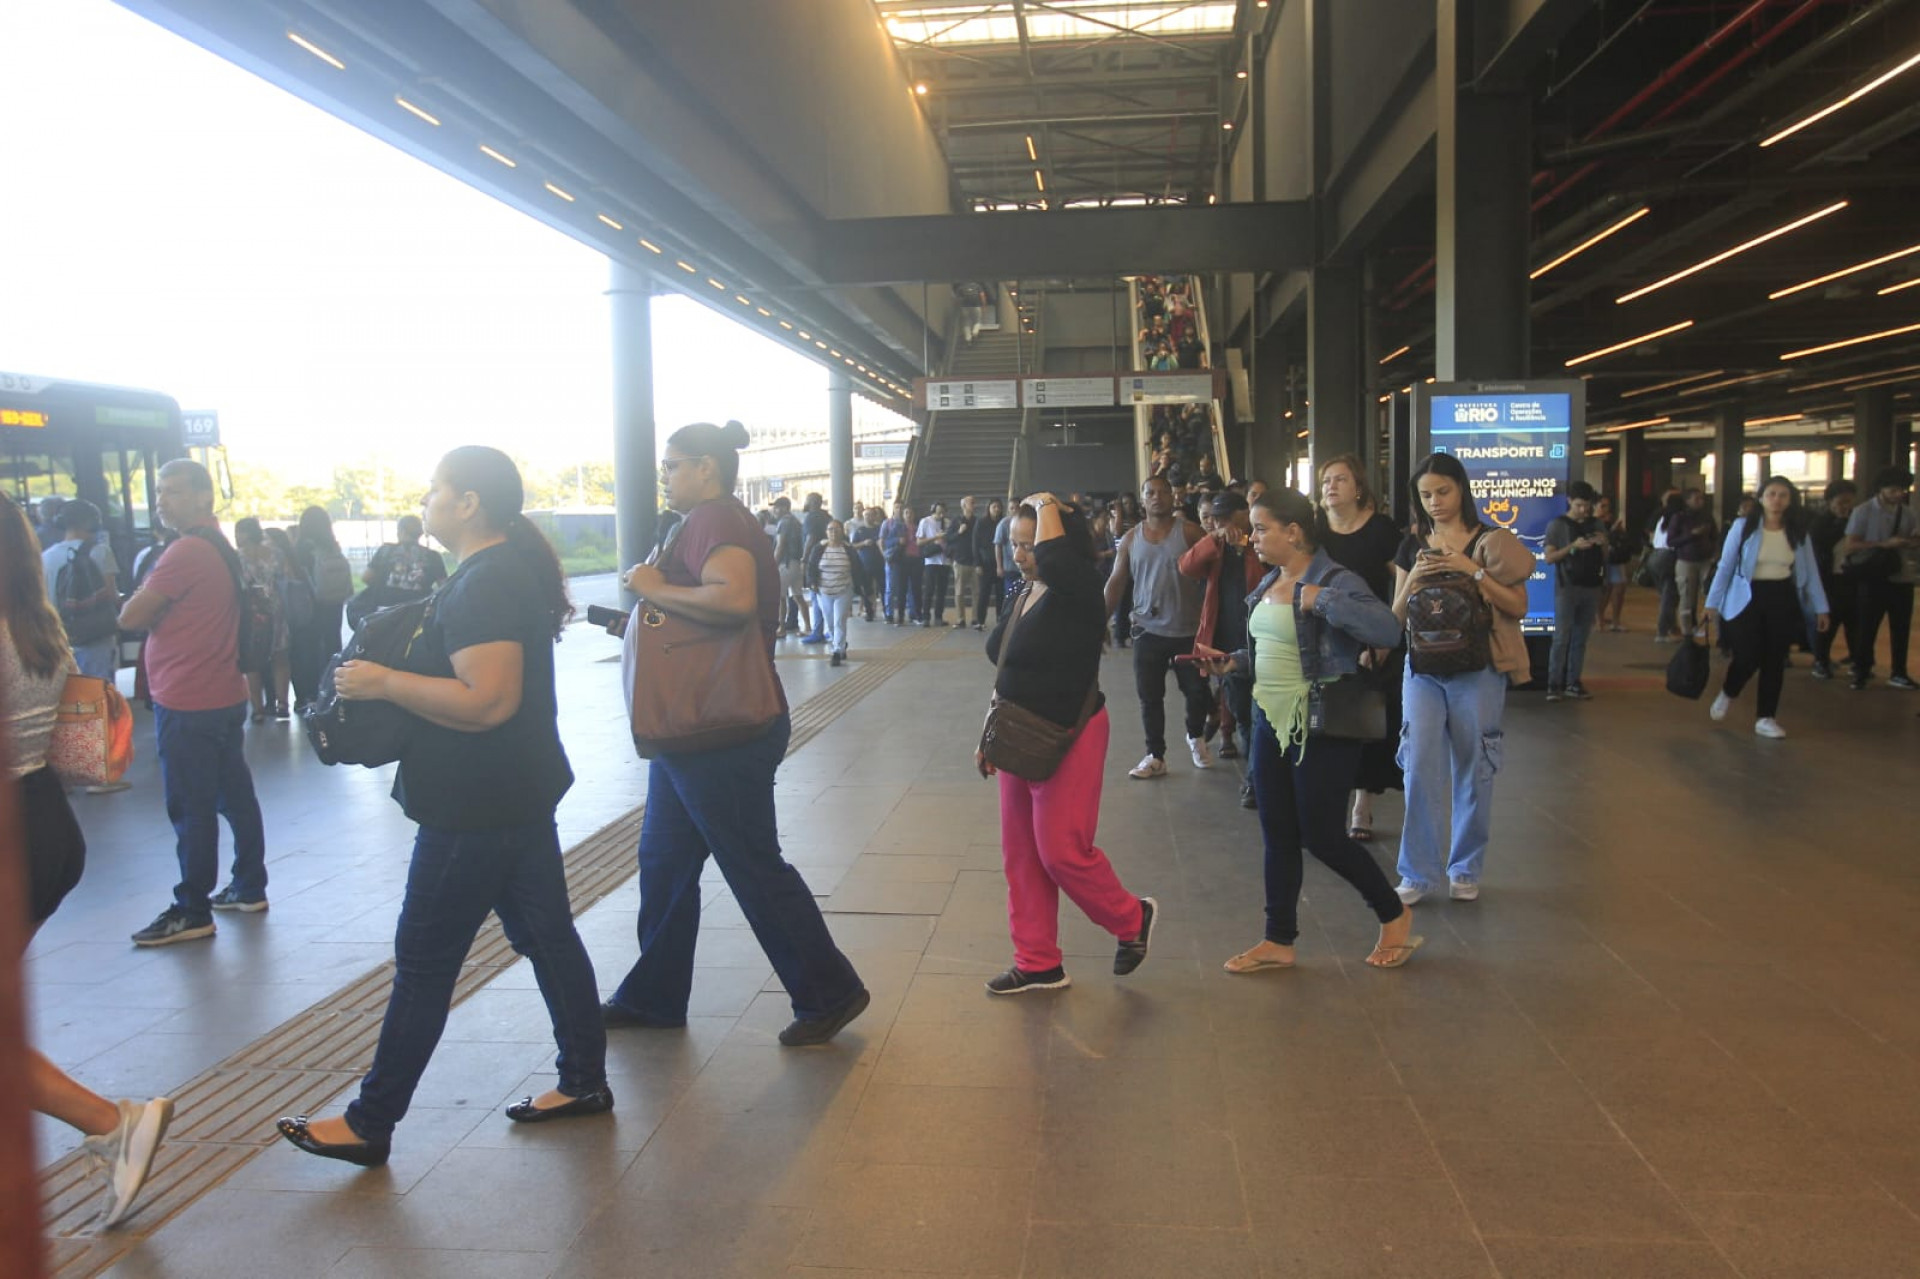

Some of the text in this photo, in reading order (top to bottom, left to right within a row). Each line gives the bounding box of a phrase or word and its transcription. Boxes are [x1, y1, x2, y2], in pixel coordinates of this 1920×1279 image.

[1468, 408, 1498, 422] RIO
[185, 419, 214, 433] 169
[1455, 446, 1544, 458] TRANSPORTE
[1470, 478, 1556, 489] EXCLUSIVO NOS
[1490, 488, 1553, 498] MUNICIPAIS
